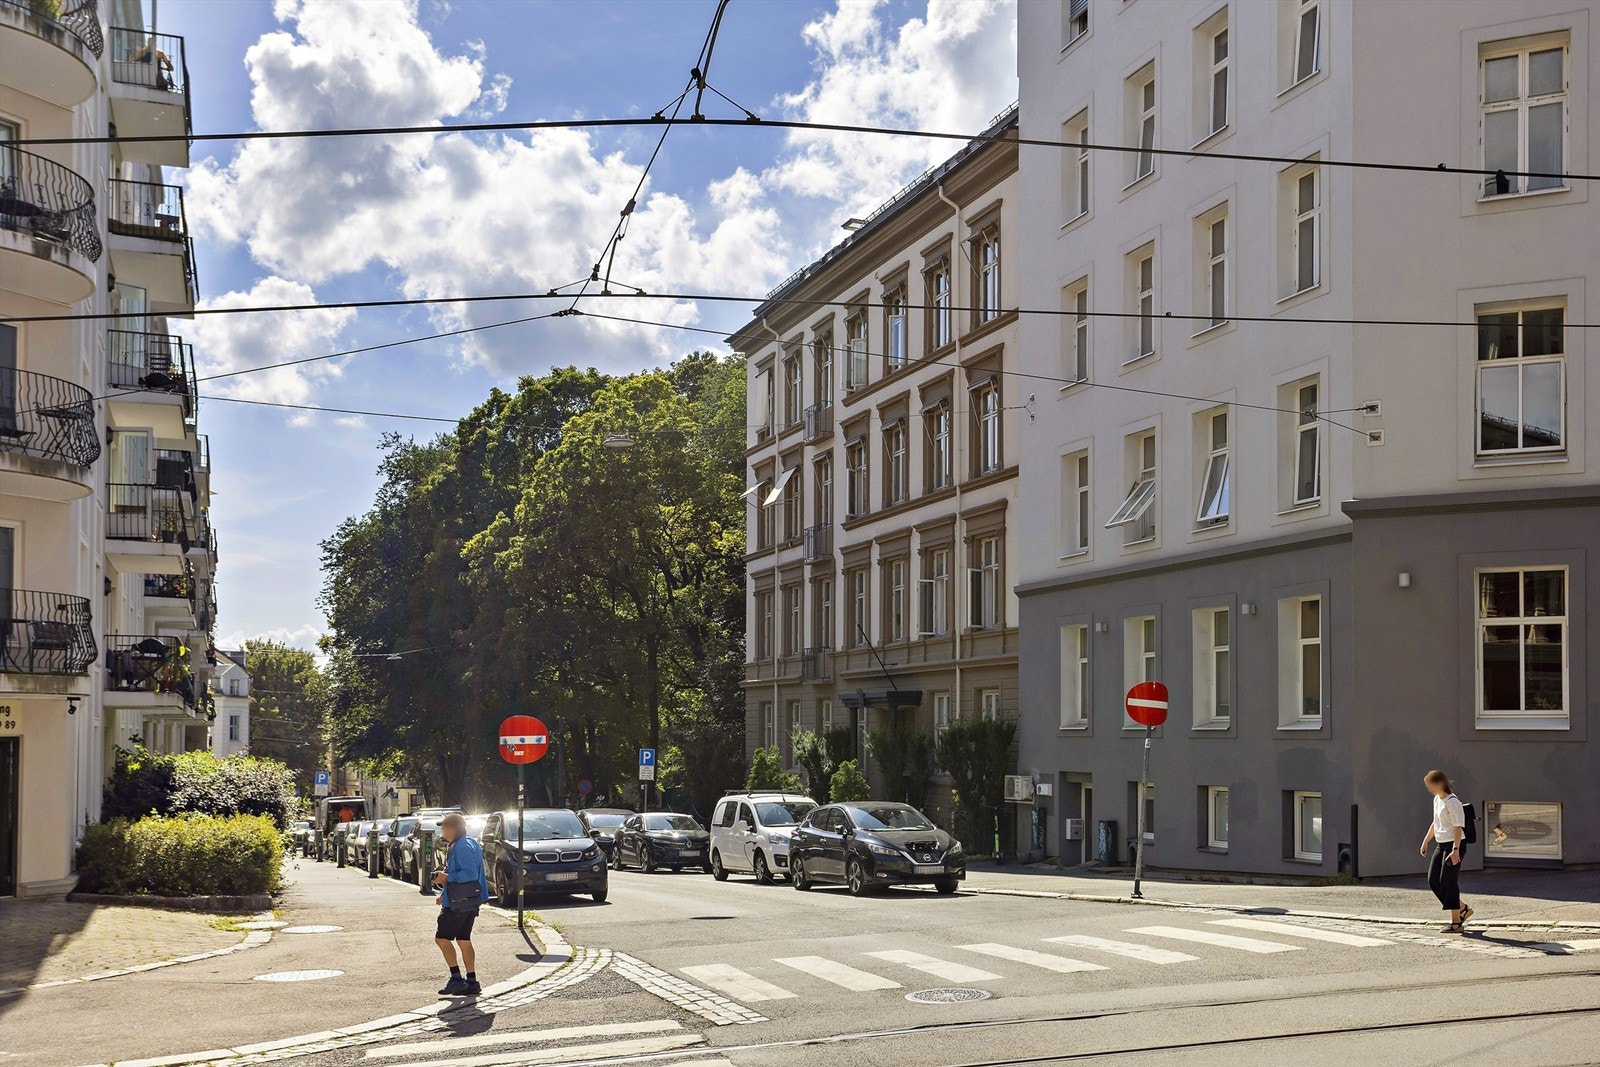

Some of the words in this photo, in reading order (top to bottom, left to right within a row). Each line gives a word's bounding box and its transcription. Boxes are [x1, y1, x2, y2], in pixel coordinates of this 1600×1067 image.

[5, 720, 16, 730] 89
[643, 751, 652, 764] P
[318, 773, 326, 784] P
